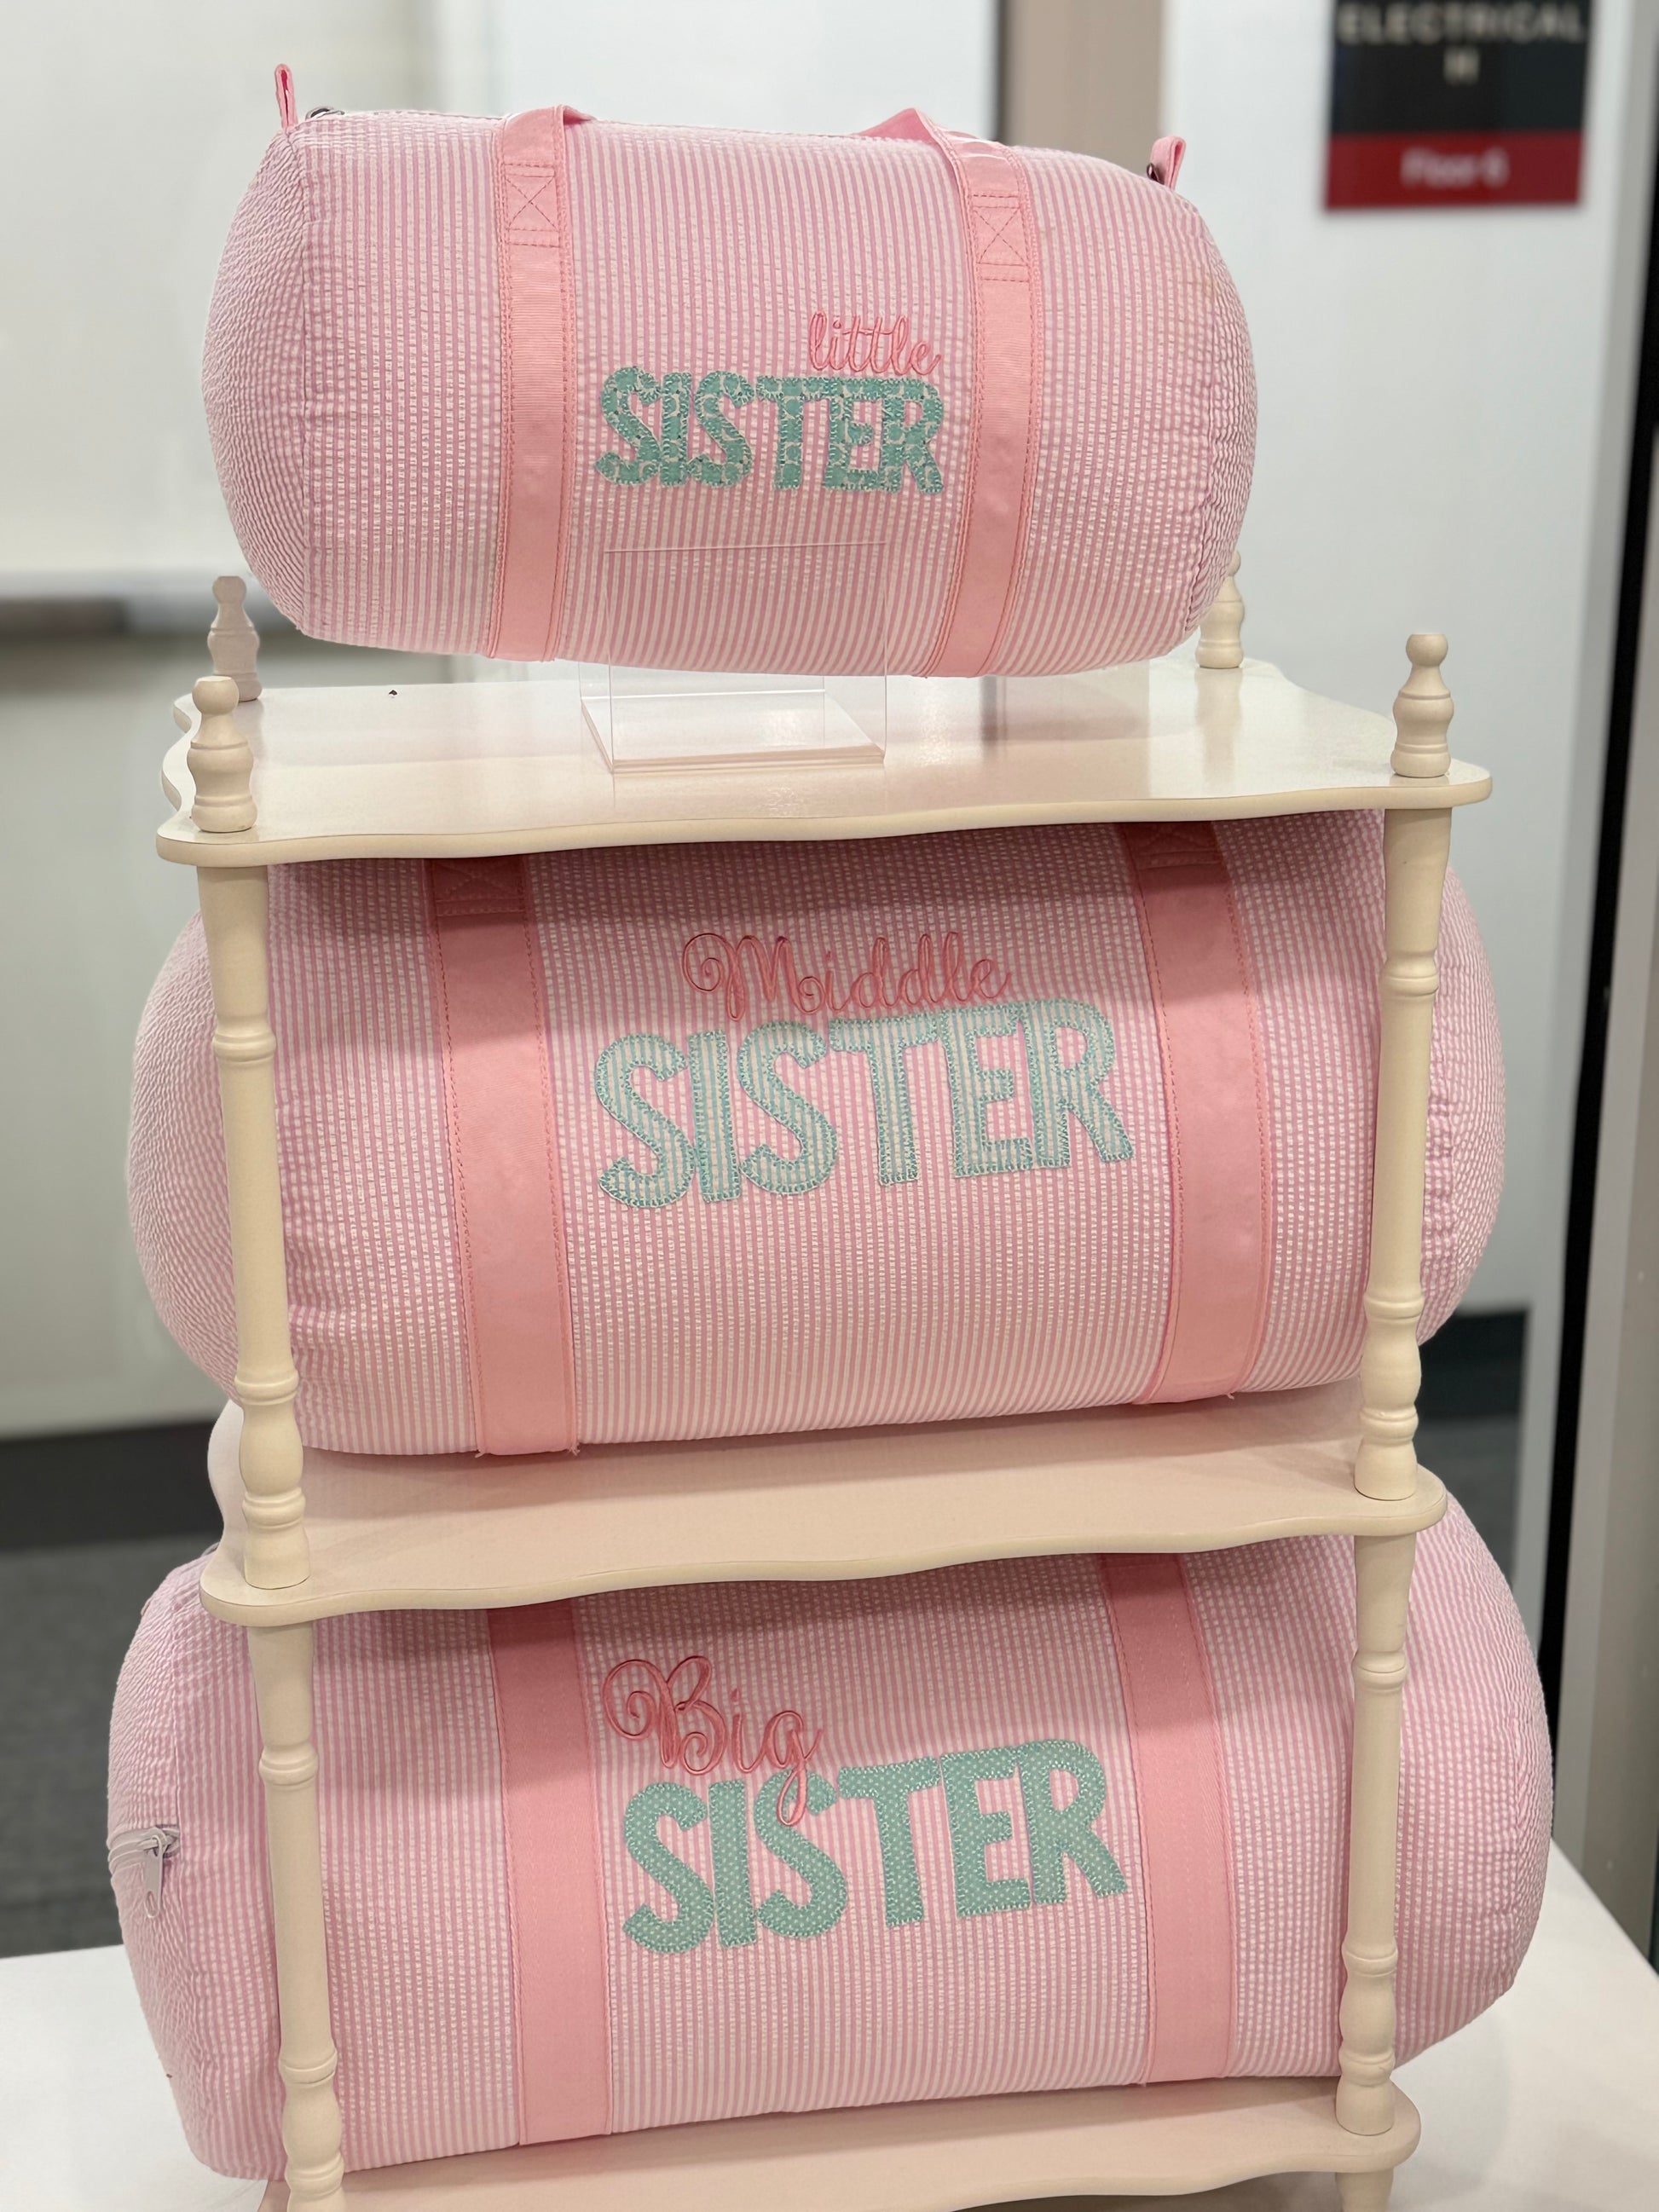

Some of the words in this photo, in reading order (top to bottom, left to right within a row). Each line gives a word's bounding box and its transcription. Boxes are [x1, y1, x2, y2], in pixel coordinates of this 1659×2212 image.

[807, 310, 942, 376] little
[595, 367, 944, 494] SISTER
[683, 932, 1013, 1023] Middle
[594, 997, 1136, 1210] SISTER
[602, 1655, 824, 1826] Big
[622, 1738, 1128, 1955] SISTER
